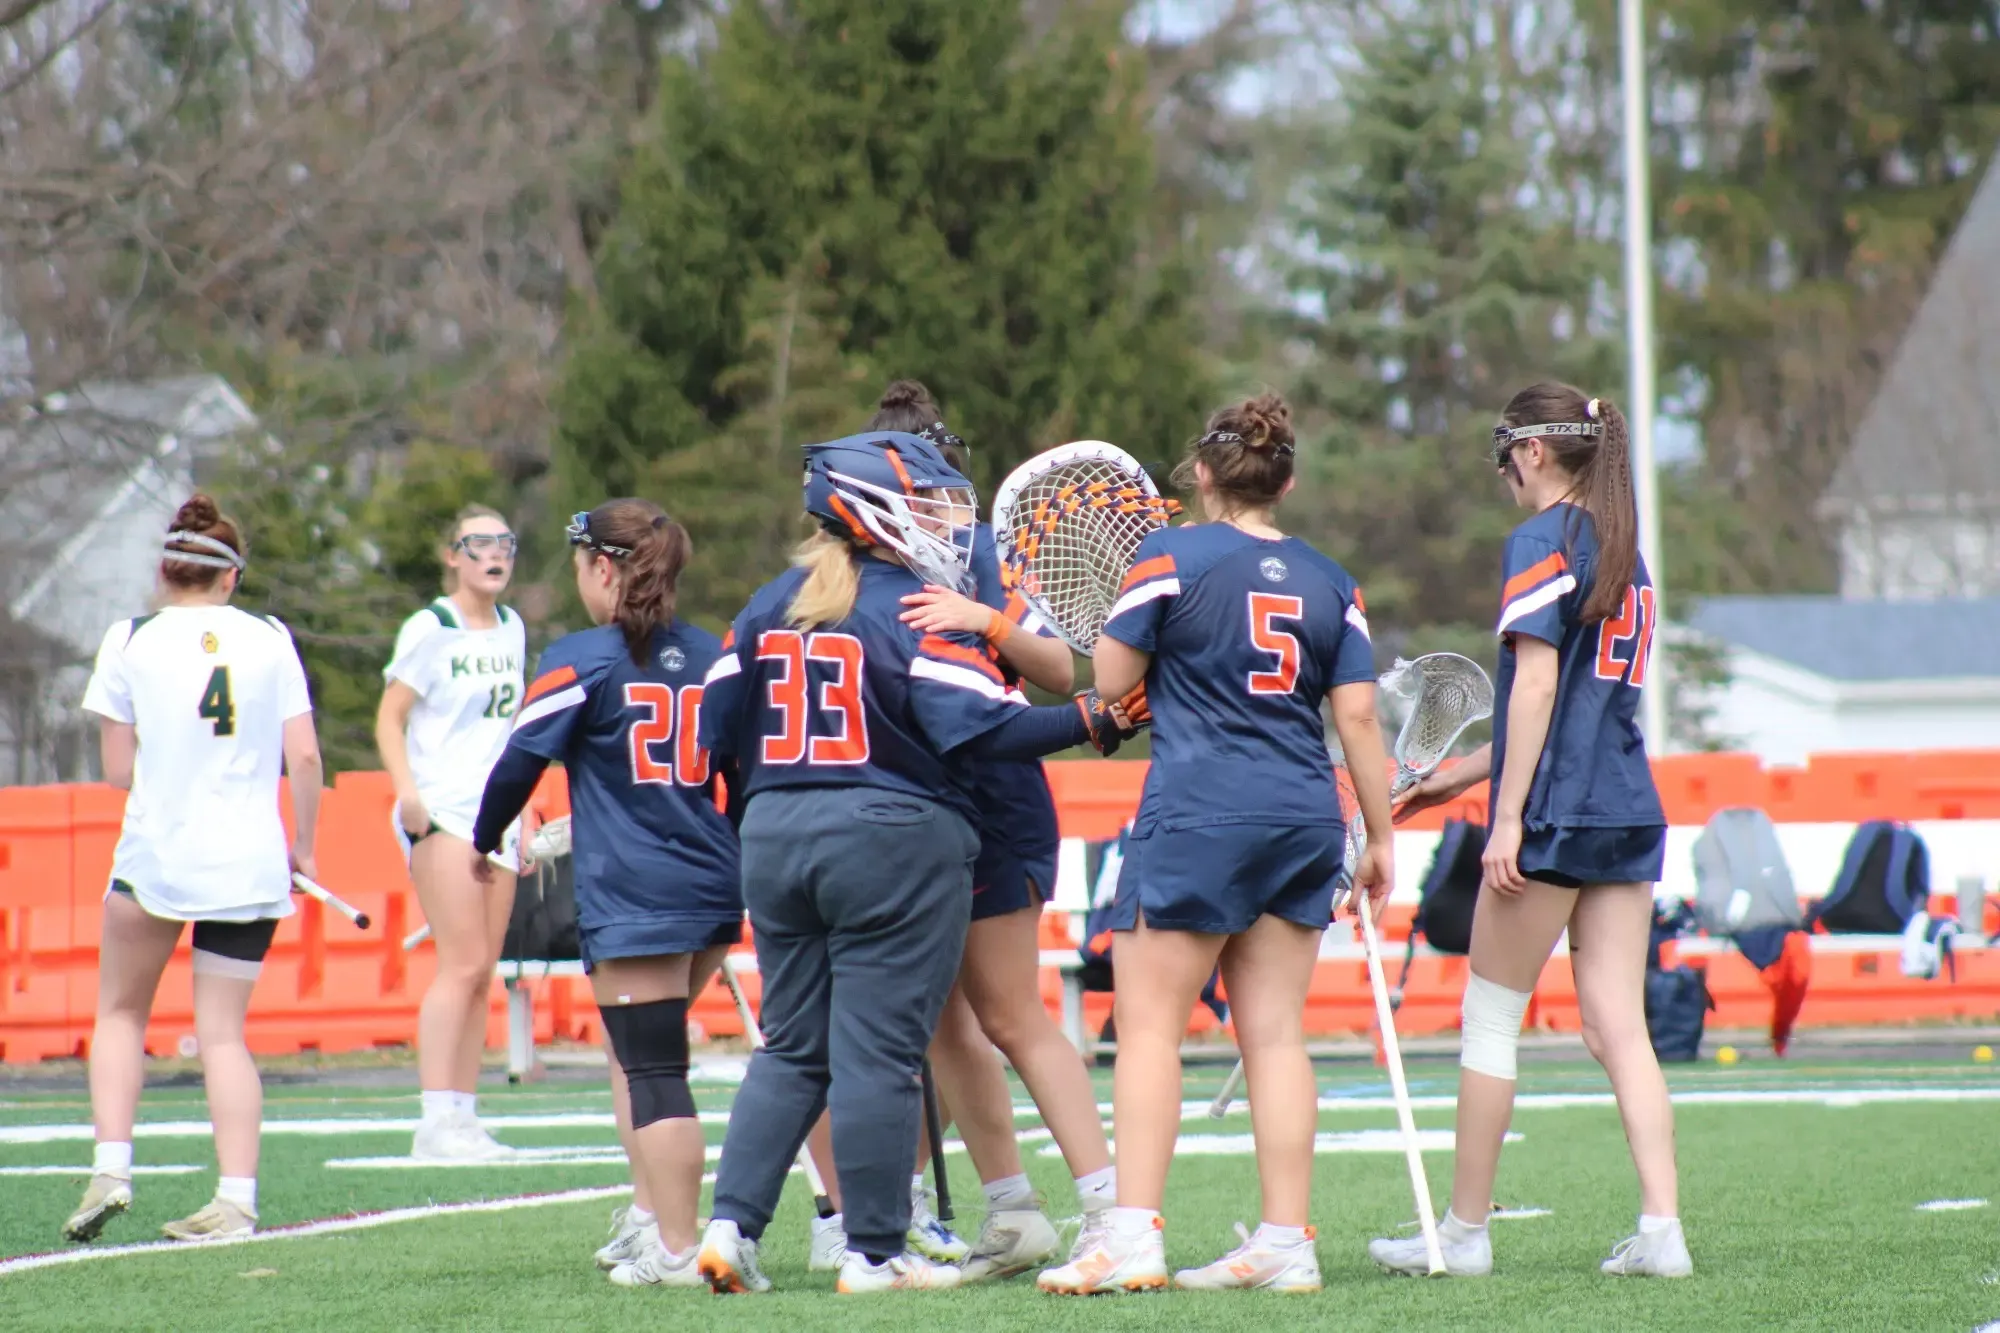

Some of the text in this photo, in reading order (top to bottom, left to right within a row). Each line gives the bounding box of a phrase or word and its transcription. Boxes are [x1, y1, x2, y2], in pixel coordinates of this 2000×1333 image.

[1545, 424, 1572, 434] STX
[1247, 591, 1303, 694] 5
[1595, 583, 1655, 688] 21
[198, 665, 235, 737] 4
[482, 683, 516, 718] 12
[624, 683, 710, 786] 20
[756, 630, 870, 765] 33
